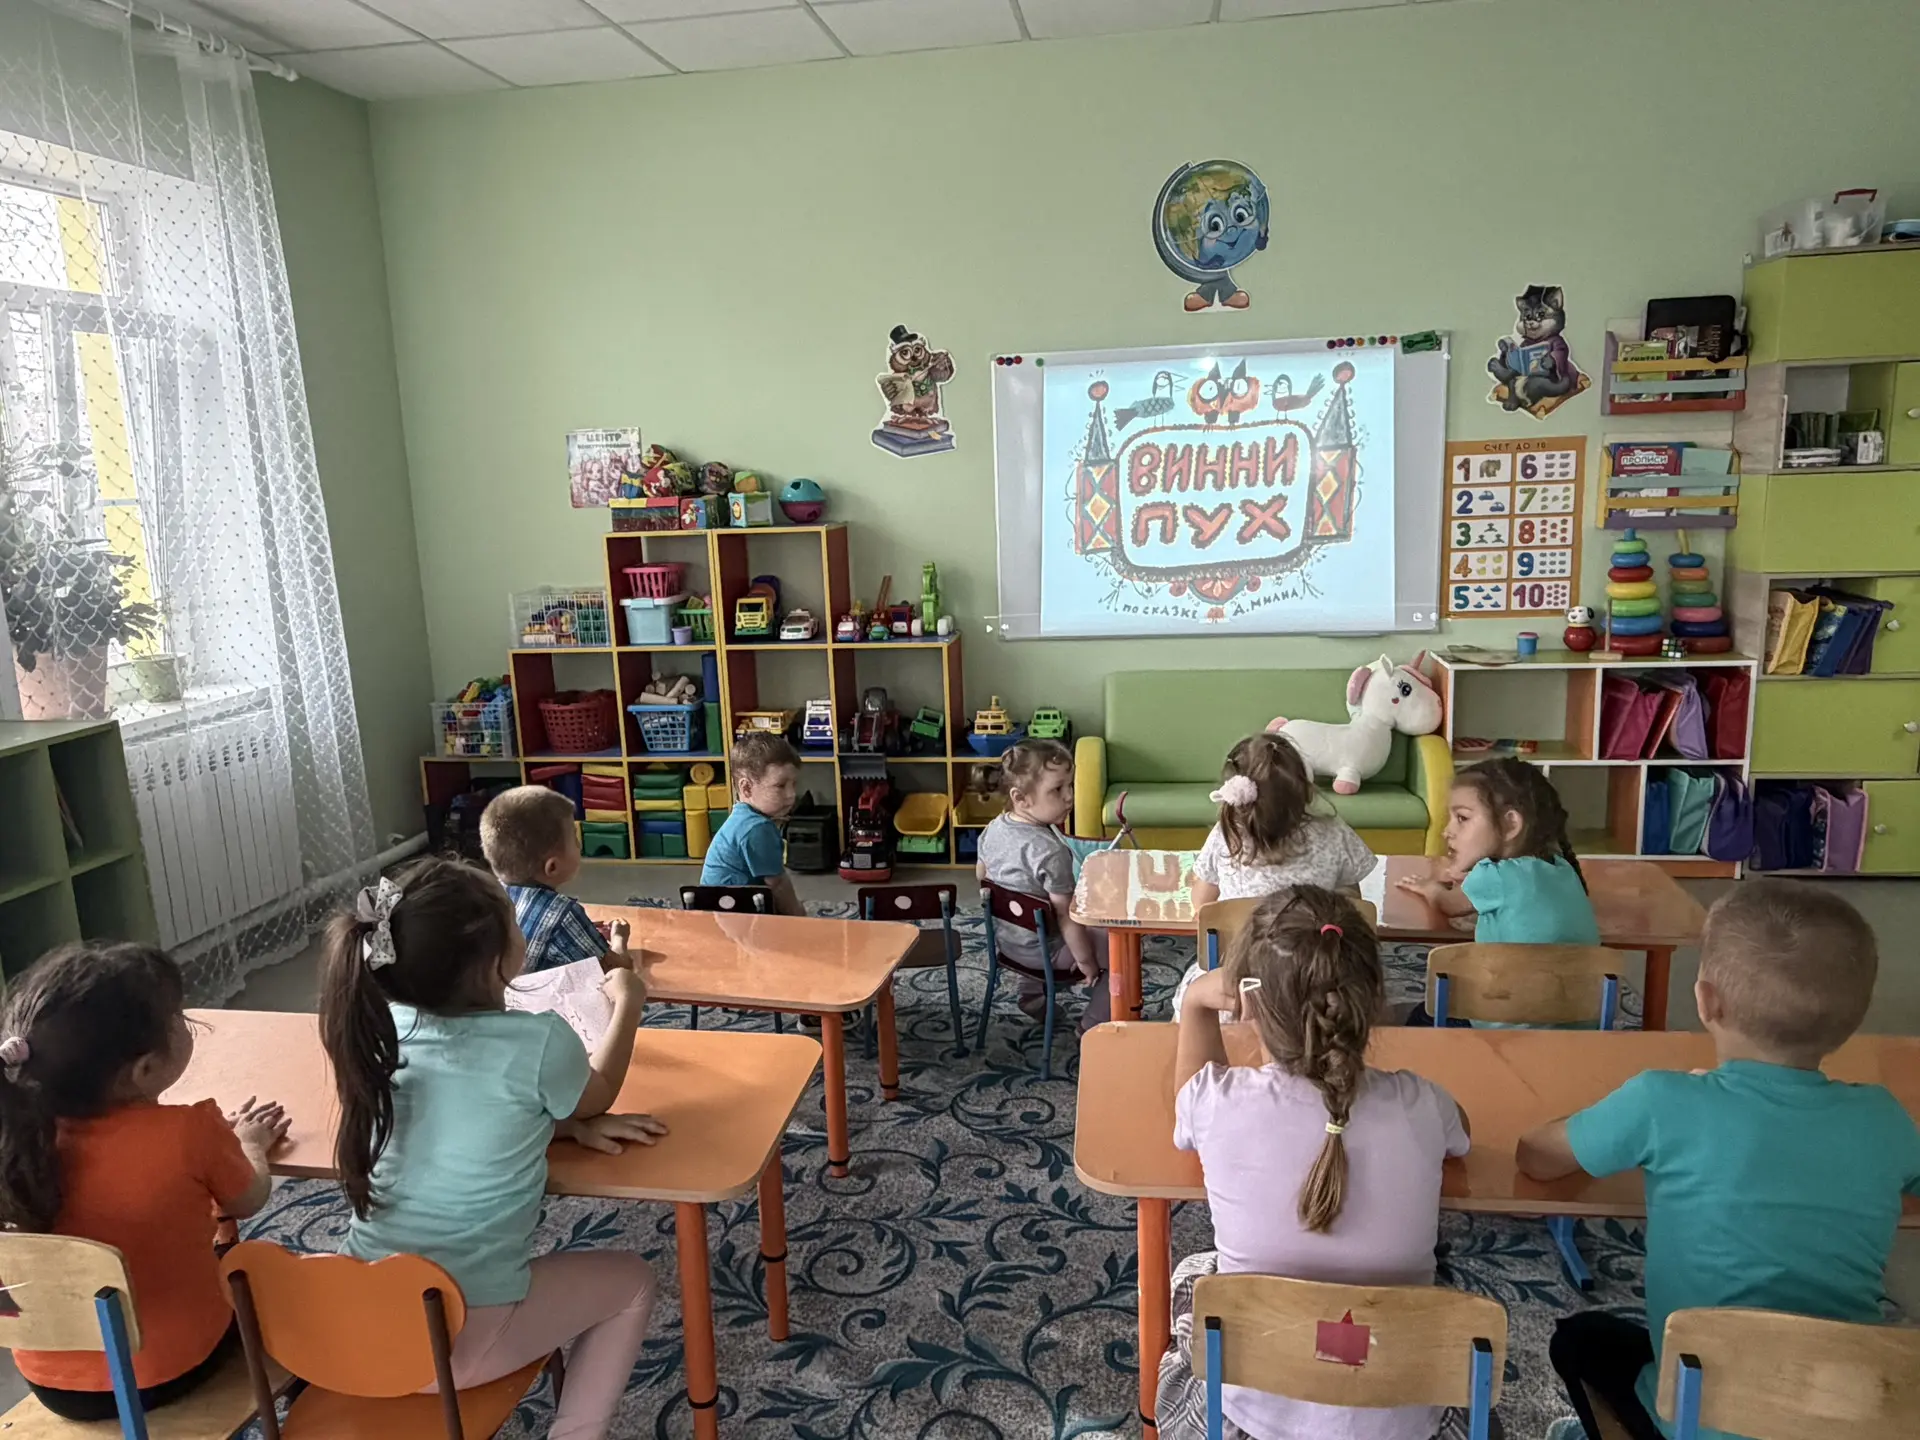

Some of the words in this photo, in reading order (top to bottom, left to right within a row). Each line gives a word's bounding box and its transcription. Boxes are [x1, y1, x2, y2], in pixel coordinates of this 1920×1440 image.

[586, 432, 622, 442] ЦЕНТР
[1516, 442, 1531, 451] ДО
[1536, 441, 1546, 449] 10
[1127, 431, 1299, 497] ВИННИ
[1457, 457, 1470, 481] 1
[1520, 454, 1537, 479] 6
[1621, 455, 1668, 464] ПРОПИСИ
[1456, 490, 1473, 514] 2
[1519, 487, 1537, 512] 7
[1131, 492, 1291, 549] ПУХ
[1518, 520, 1535, 544] 8
[1456, 522, 1471, 546] 3
[1454, 554, 1472, 578] 4
[1517, 552, 1534, 576] 9
[1454, 585, 1470, 609] 5
[1512, 583, 1544, 608] 10
[1142, 604, 1198, 620] СКАЗКЕ
